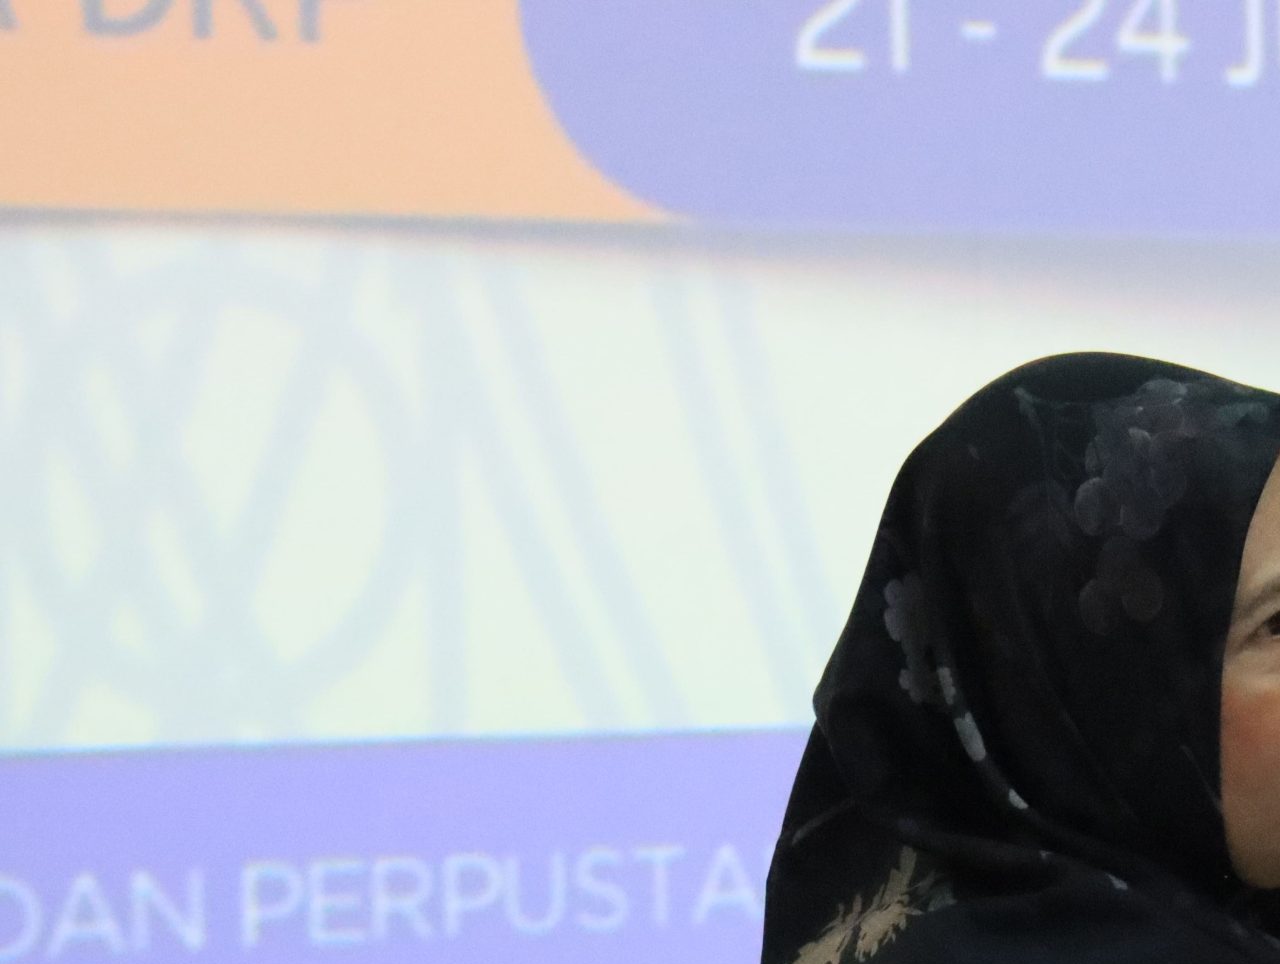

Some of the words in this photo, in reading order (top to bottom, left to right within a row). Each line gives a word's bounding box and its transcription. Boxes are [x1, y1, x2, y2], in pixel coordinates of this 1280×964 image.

[796, 0, 909, 72] 21
[1041, 0, 1190, 83] 24
[240, 843, 766, 950] PERPUSTA
